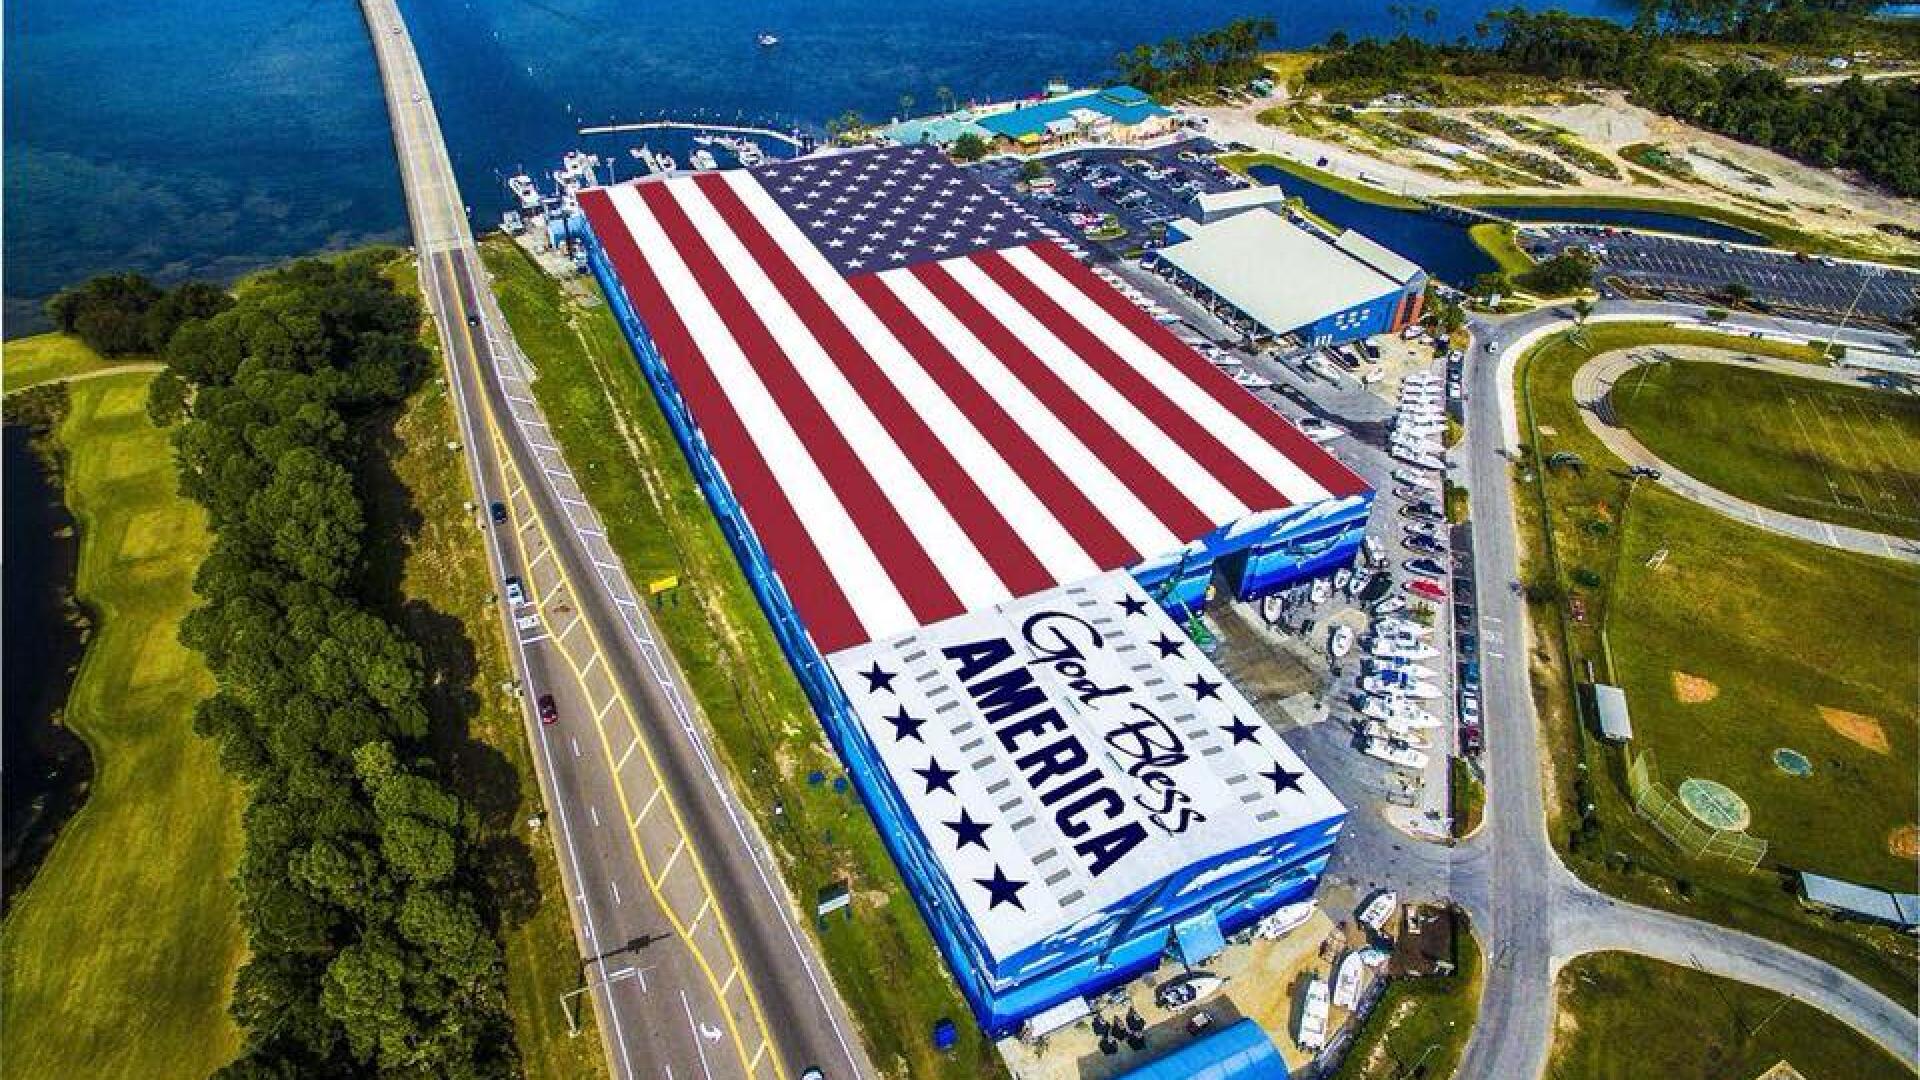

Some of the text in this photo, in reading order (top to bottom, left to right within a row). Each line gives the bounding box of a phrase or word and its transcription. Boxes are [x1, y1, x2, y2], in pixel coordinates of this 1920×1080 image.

[941, 637, 1149, 877] AMERICA
[1022, 611, 1206, 836] God Bless
